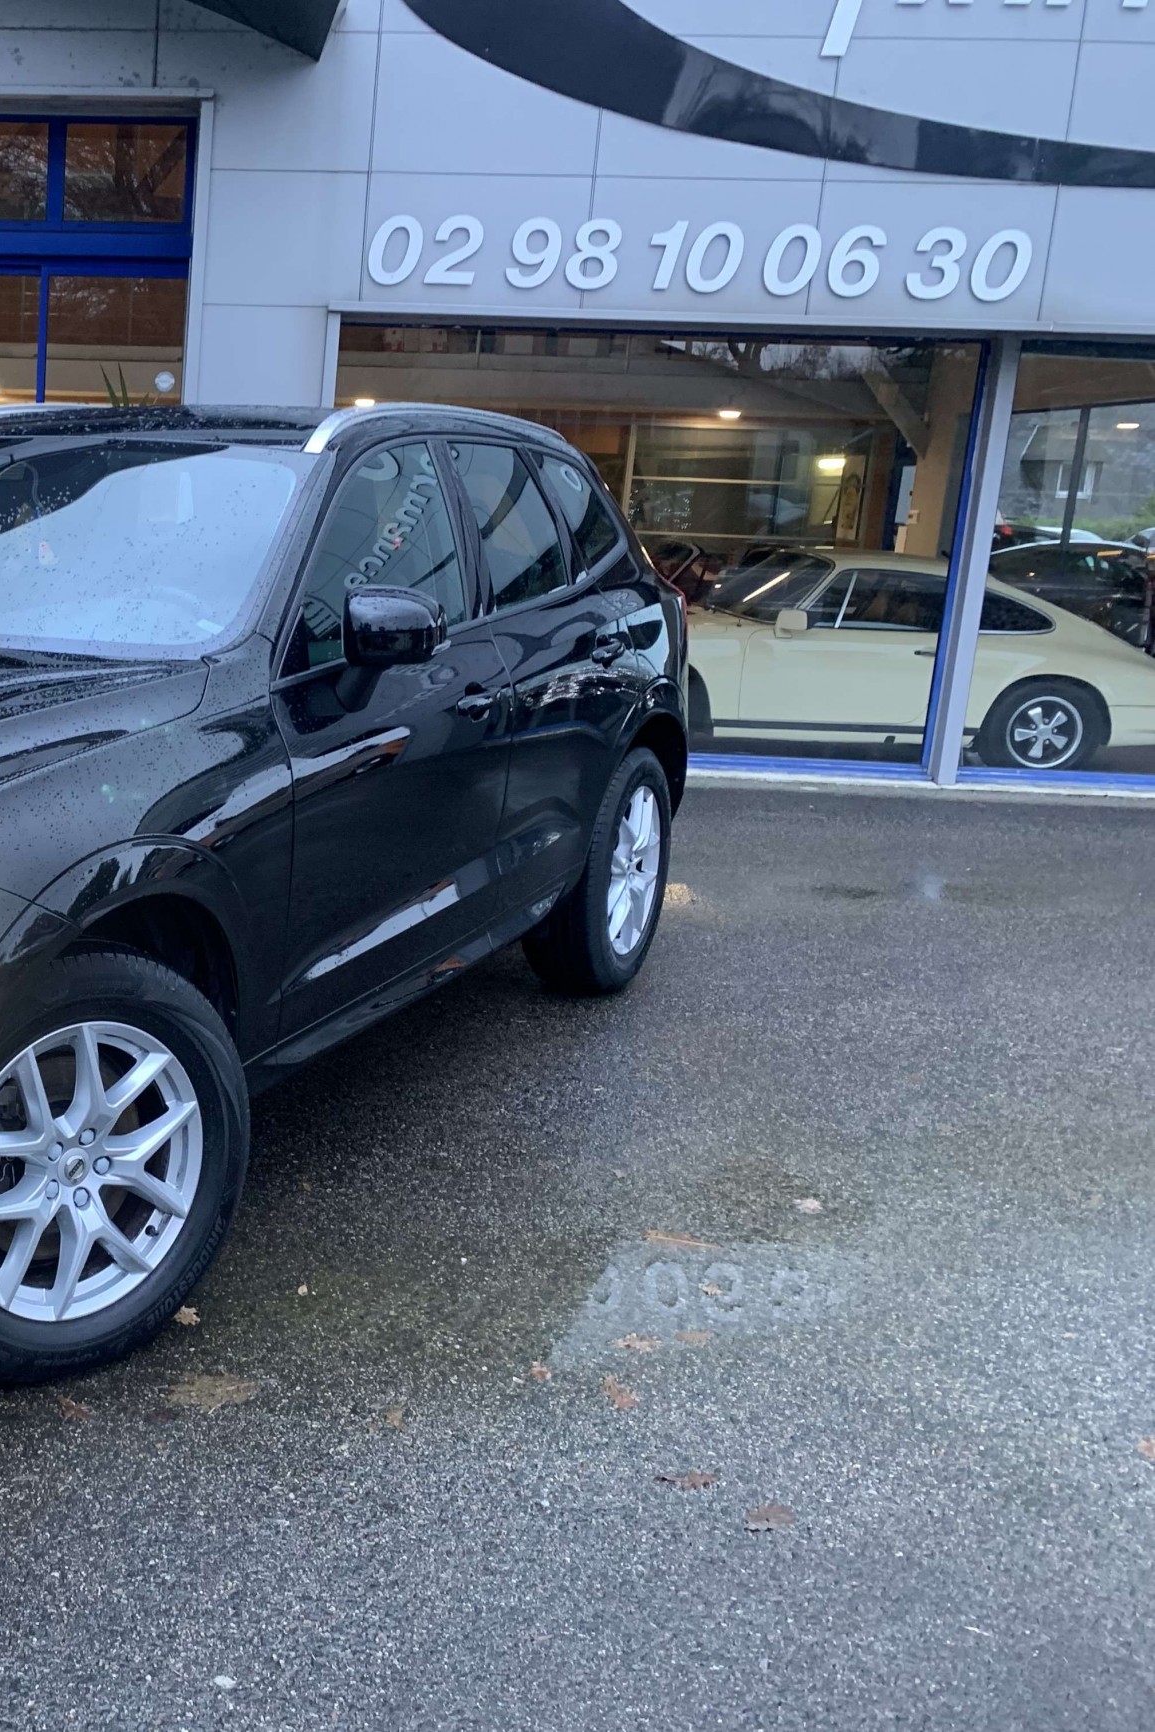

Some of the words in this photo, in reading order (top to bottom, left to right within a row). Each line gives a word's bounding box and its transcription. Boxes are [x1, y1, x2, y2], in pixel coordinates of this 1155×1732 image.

[367, 214, 485, 286] 02
[505, 216, 623, 290] 98
[650, 220, 745, 294] 10
[763, 223, 888, 297] 06
[906, 226, 1033, 302] 30
